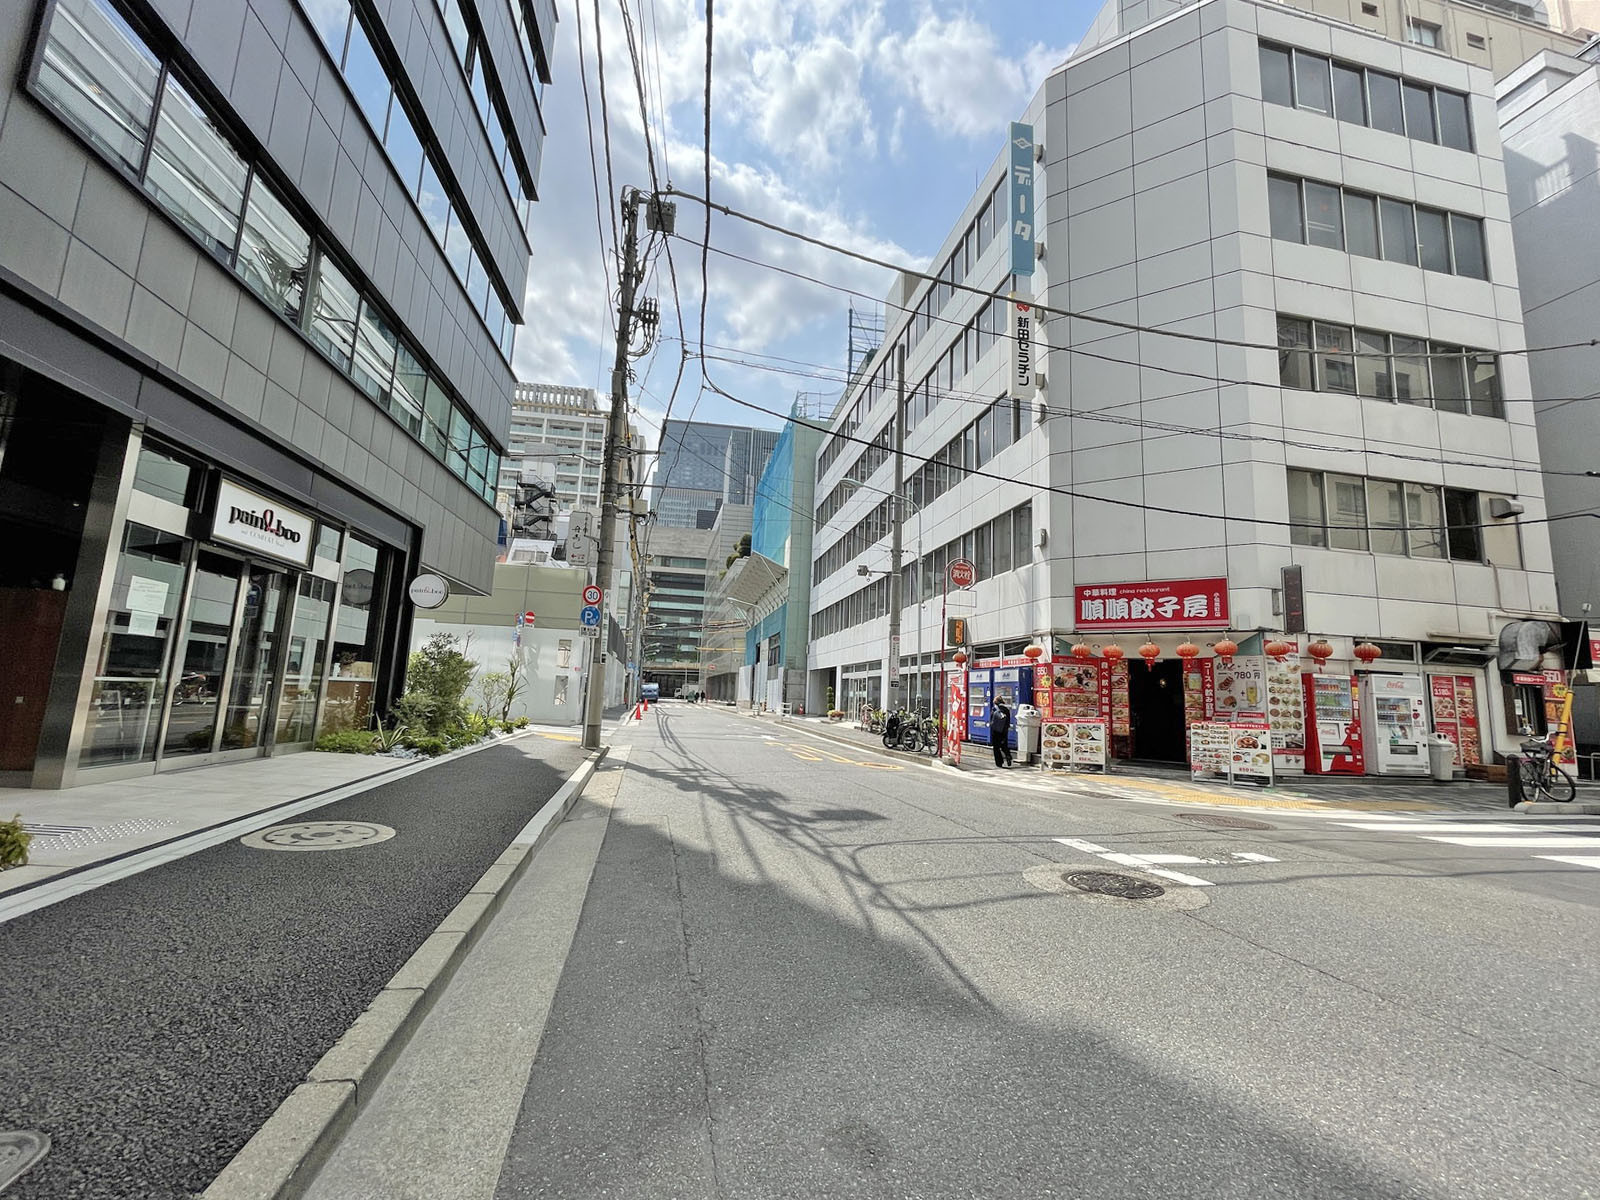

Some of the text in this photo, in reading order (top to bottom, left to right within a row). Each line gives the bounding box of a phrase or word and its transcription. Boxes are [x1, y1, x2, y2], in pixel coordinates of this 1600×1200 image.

[1014, 165, 1031, 241] データ
[587, 590, 598, 600] 30
[1083, 588, 1117, 597] 中華料理
[1081, 594, 1209, 620] 順順餃子房
[585, 611, 594, 624] P
